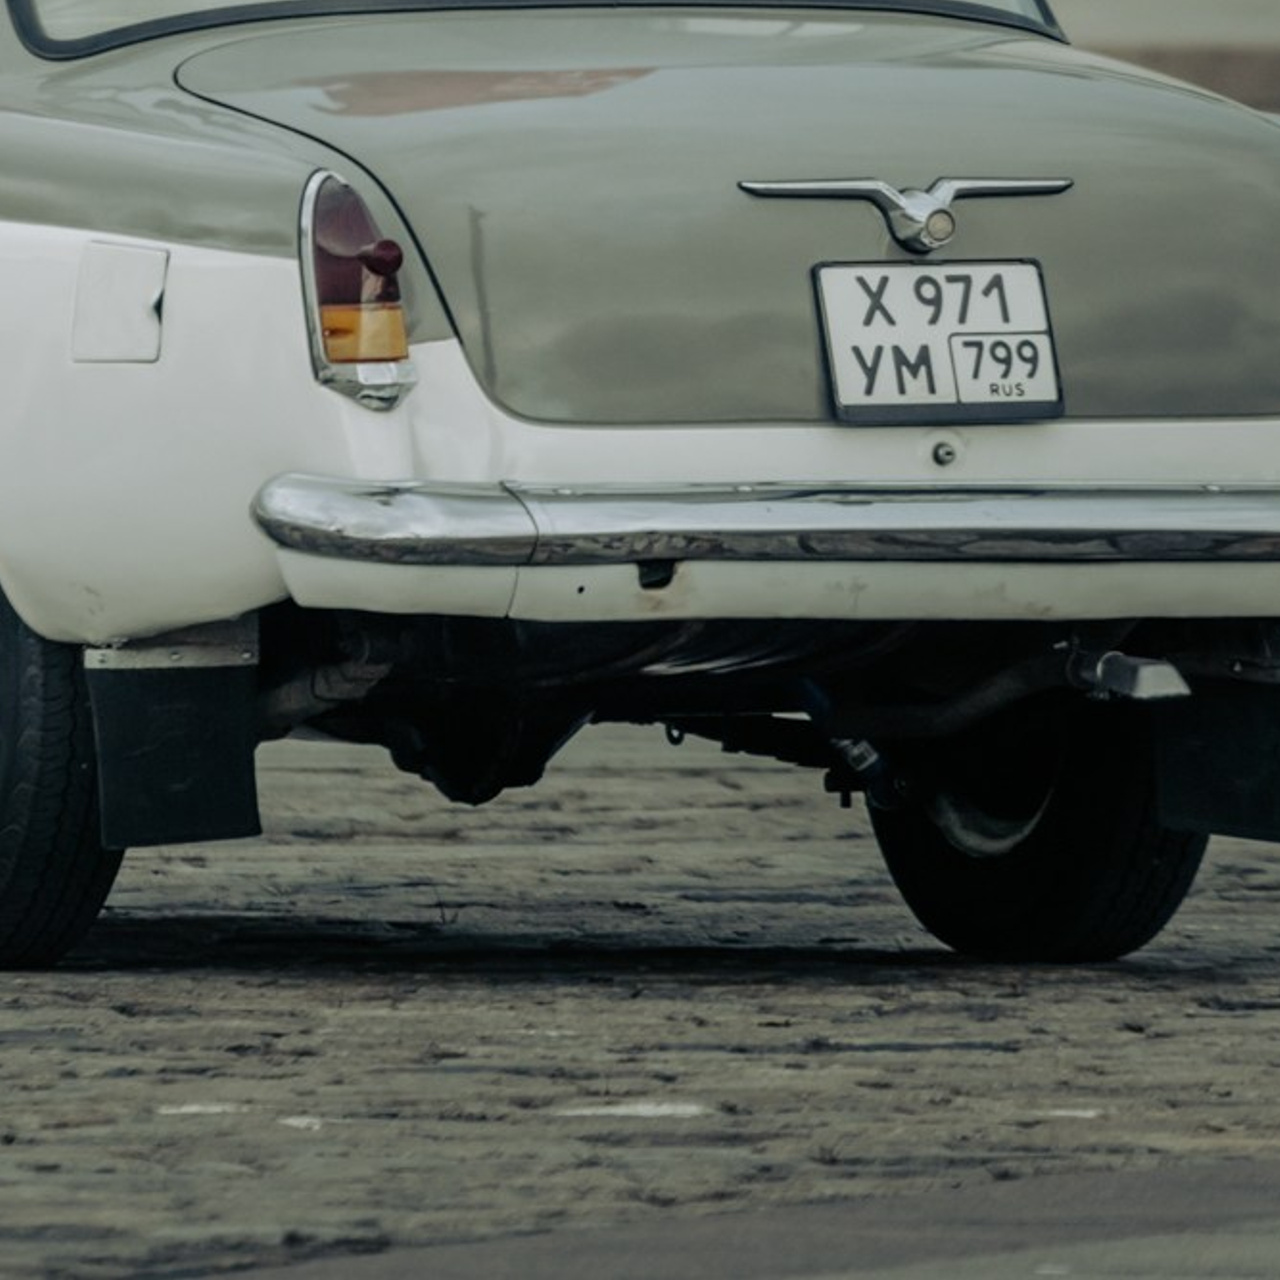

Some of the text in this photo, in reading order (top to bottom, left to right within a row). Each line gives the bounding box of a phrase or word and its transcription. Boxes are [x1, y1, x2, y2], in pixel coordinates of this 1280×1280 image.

[913, 273, 1011, 326] 971
[851, 344, 937, 397] УМ
[961, 339, 1039, 380] 799
[989, 383, 1026, 397] RUS
